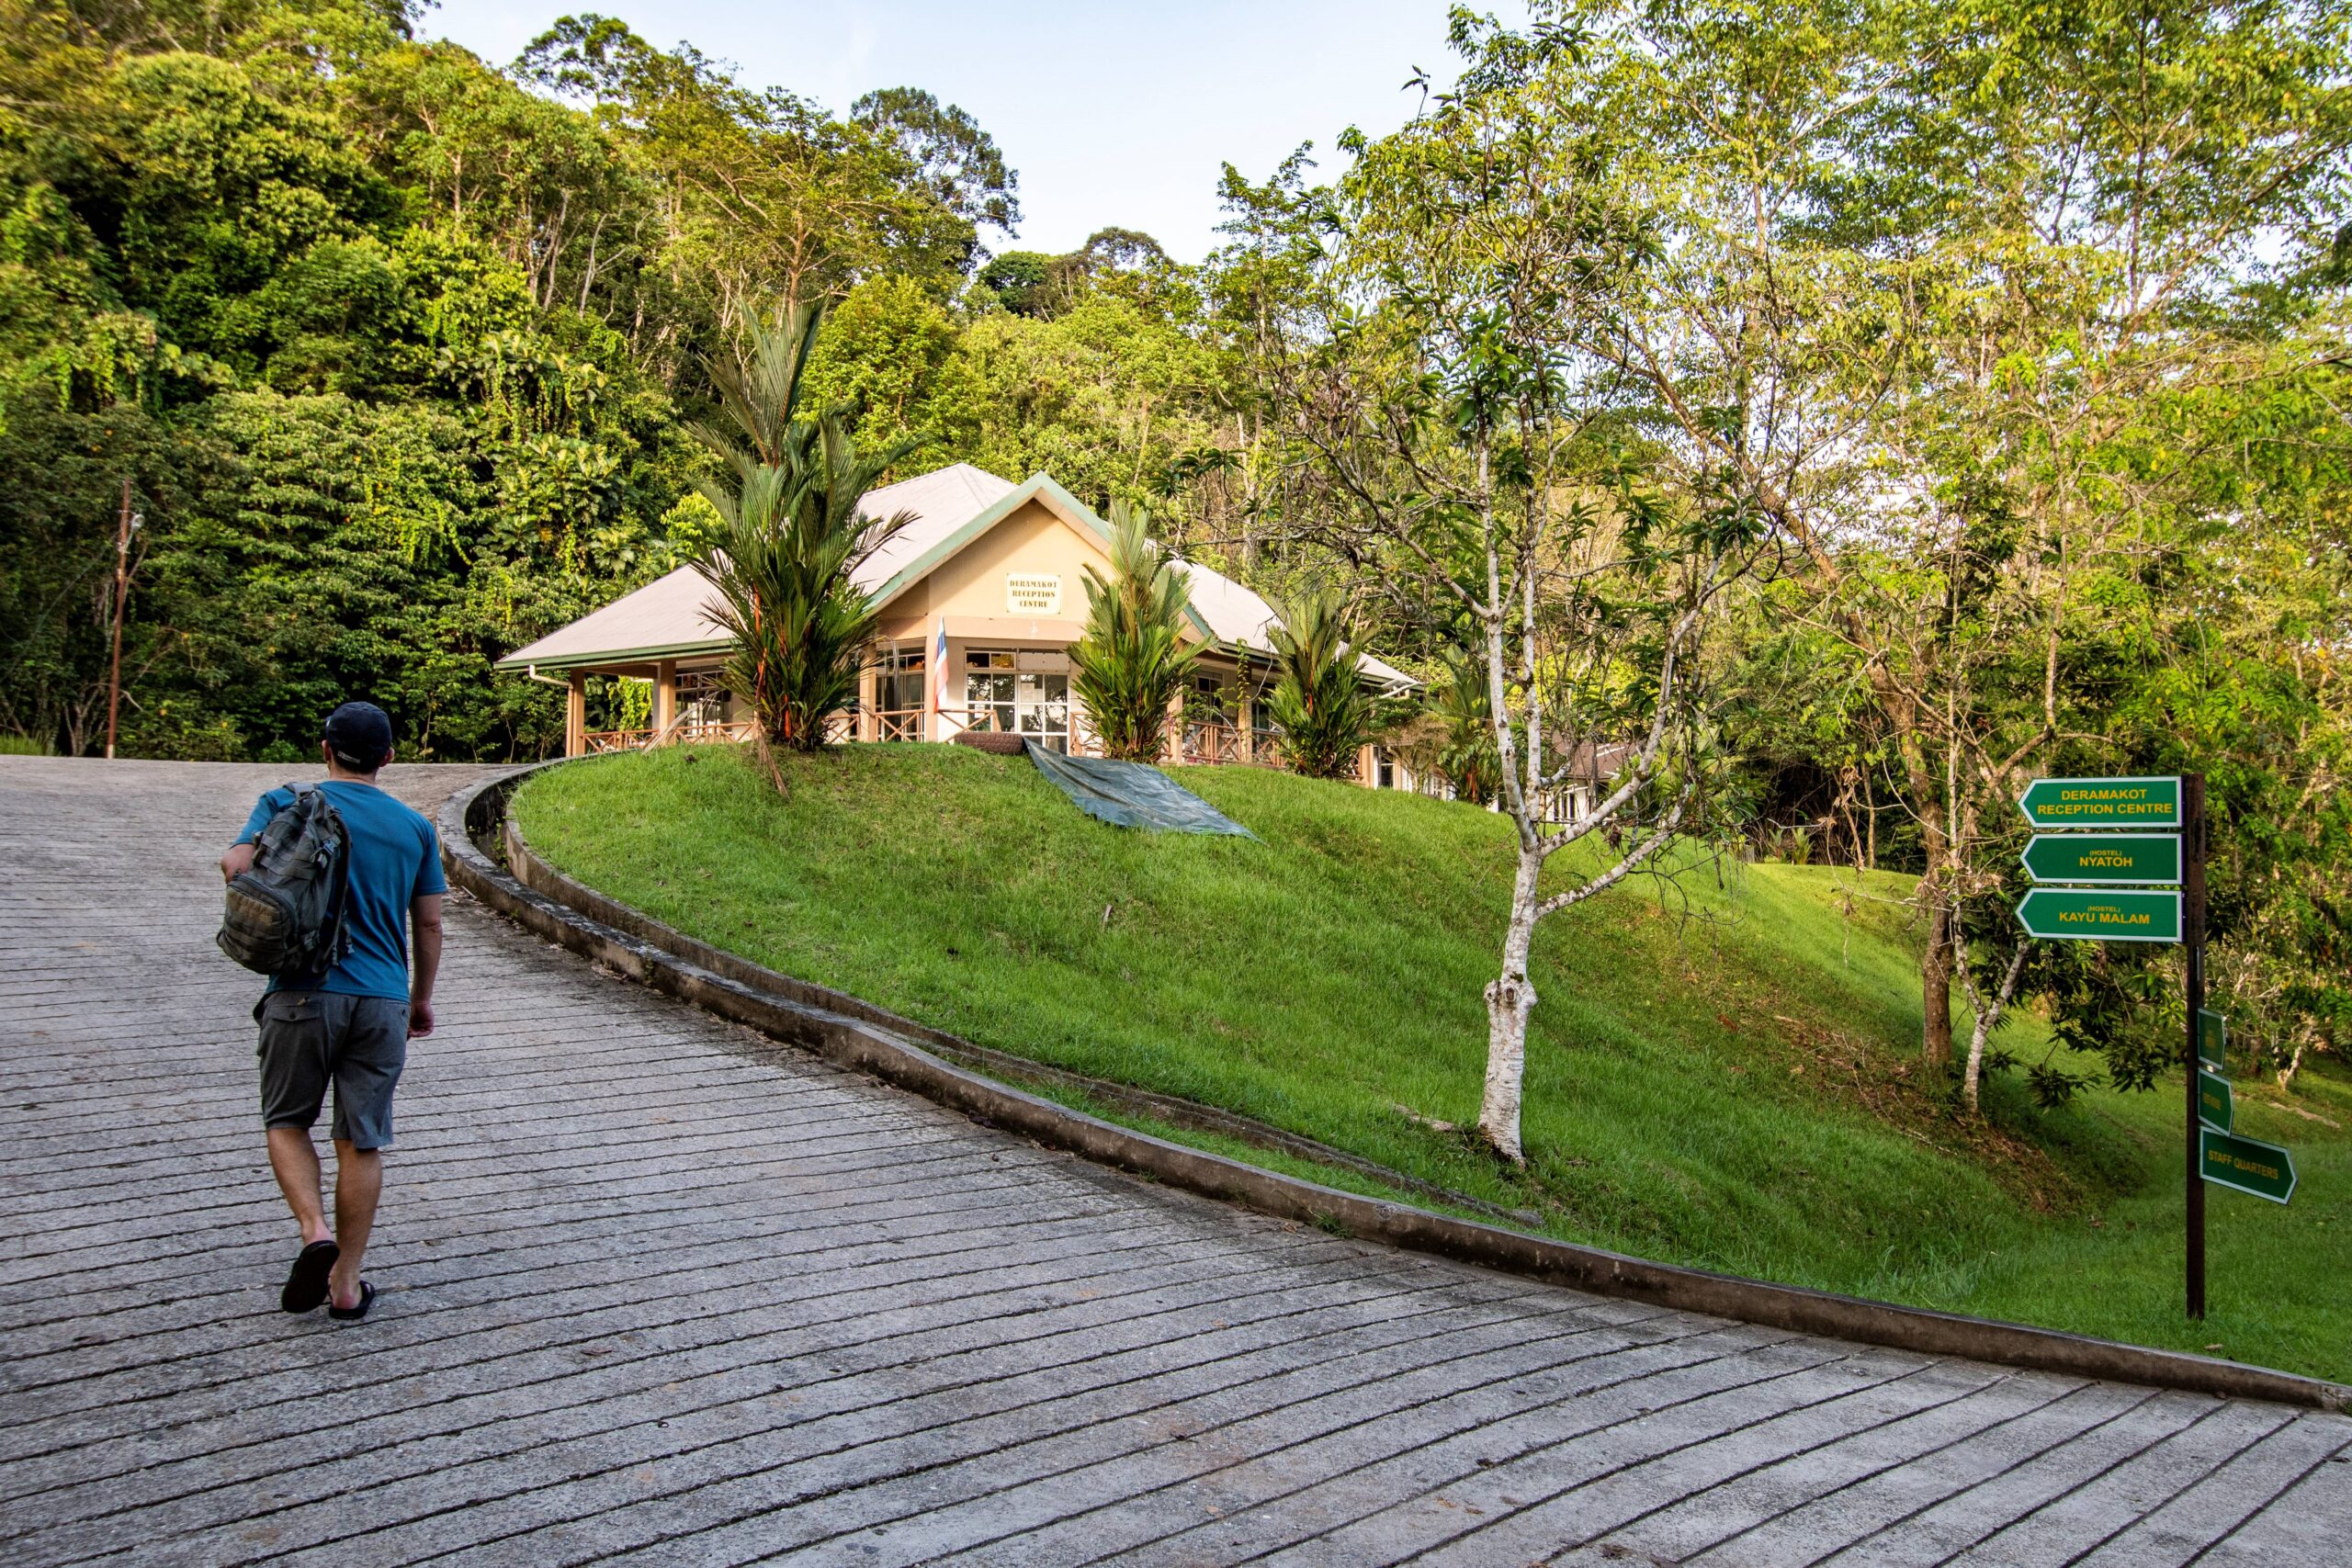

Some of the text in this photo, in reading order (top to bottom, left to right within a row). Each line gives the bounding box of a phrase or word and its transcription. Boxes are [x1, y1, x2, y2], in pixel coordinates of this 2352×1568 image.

[2061, 789, 2147, 801] DERAMAKOT
[2037, 803, 2173, 815] RECEPTION CENTRE
[2079, 857, 2132, 867] NYATOH
[2059, 912, 2150, 924] KAYU MALAM
[2208, 1149, 2278, 1180] STAFF QUARTERS
